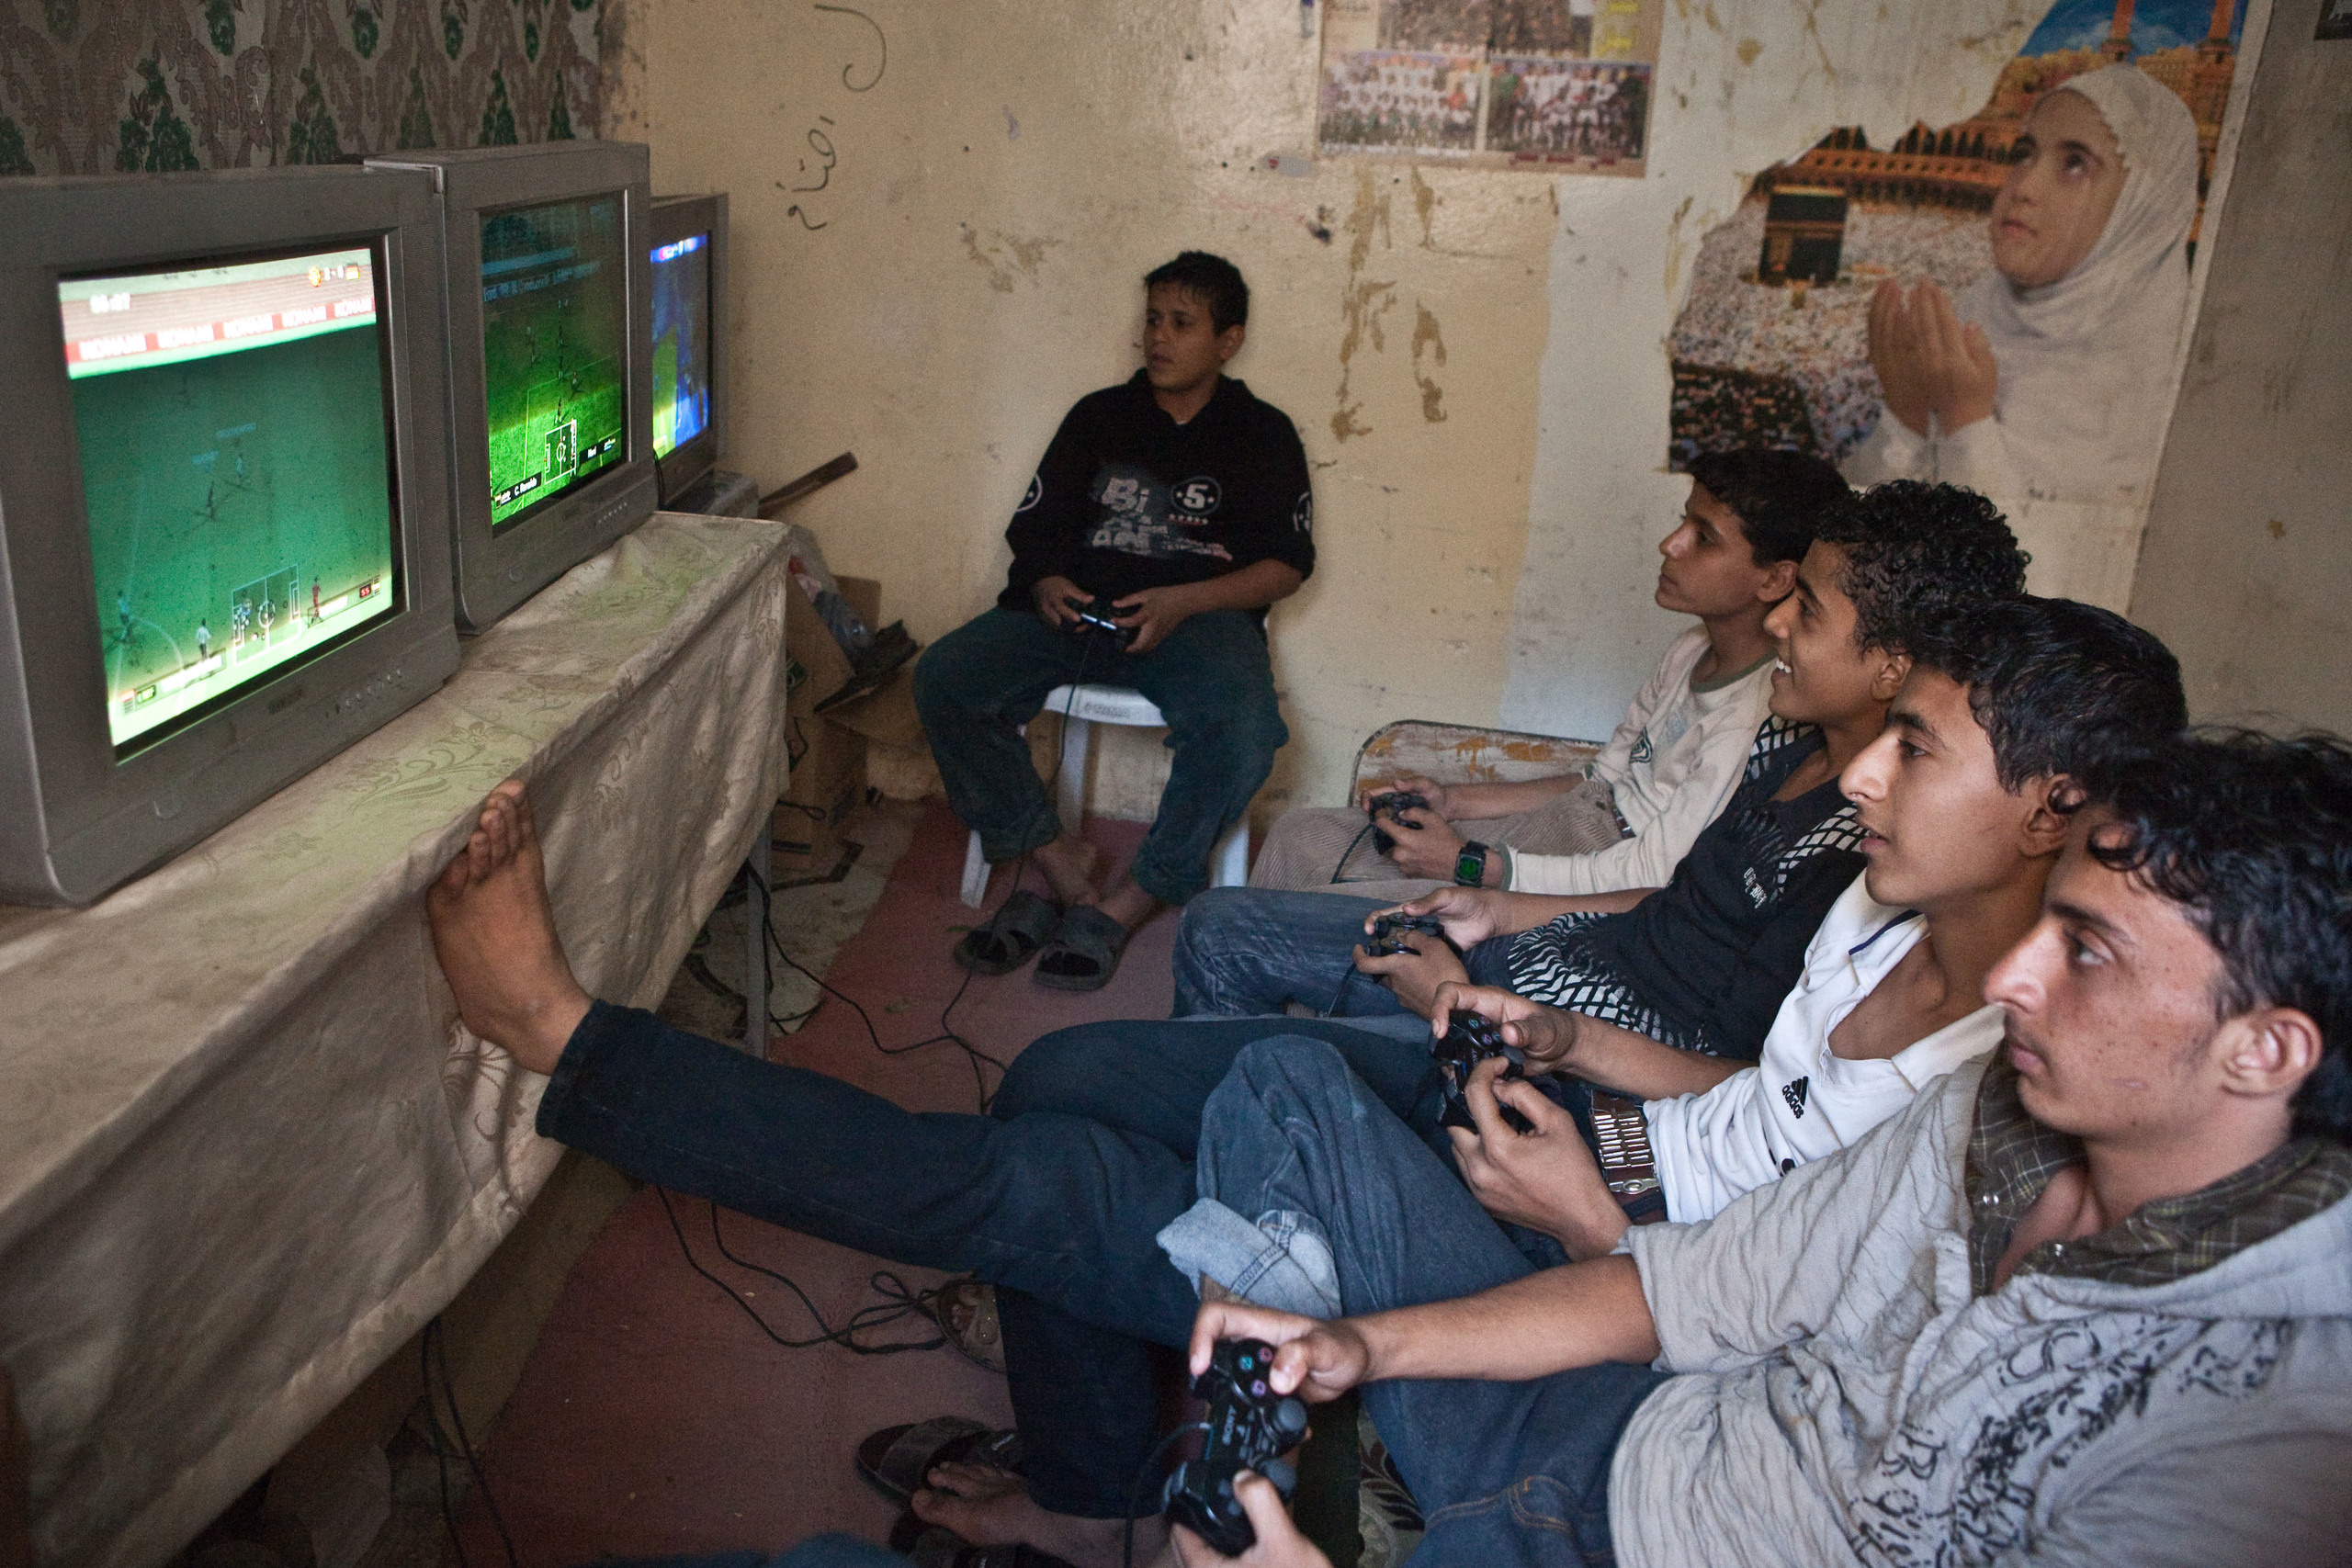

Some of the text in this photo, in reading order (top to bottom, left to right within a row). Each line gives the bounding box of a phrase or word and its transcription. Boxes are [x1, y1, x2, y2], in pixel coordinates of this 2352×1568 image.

[79, 297, 372, 361] KONAMI KONAMI KONAMI KONAMI KONAMI
[1782, 1085, 1804, 1120] adidas
